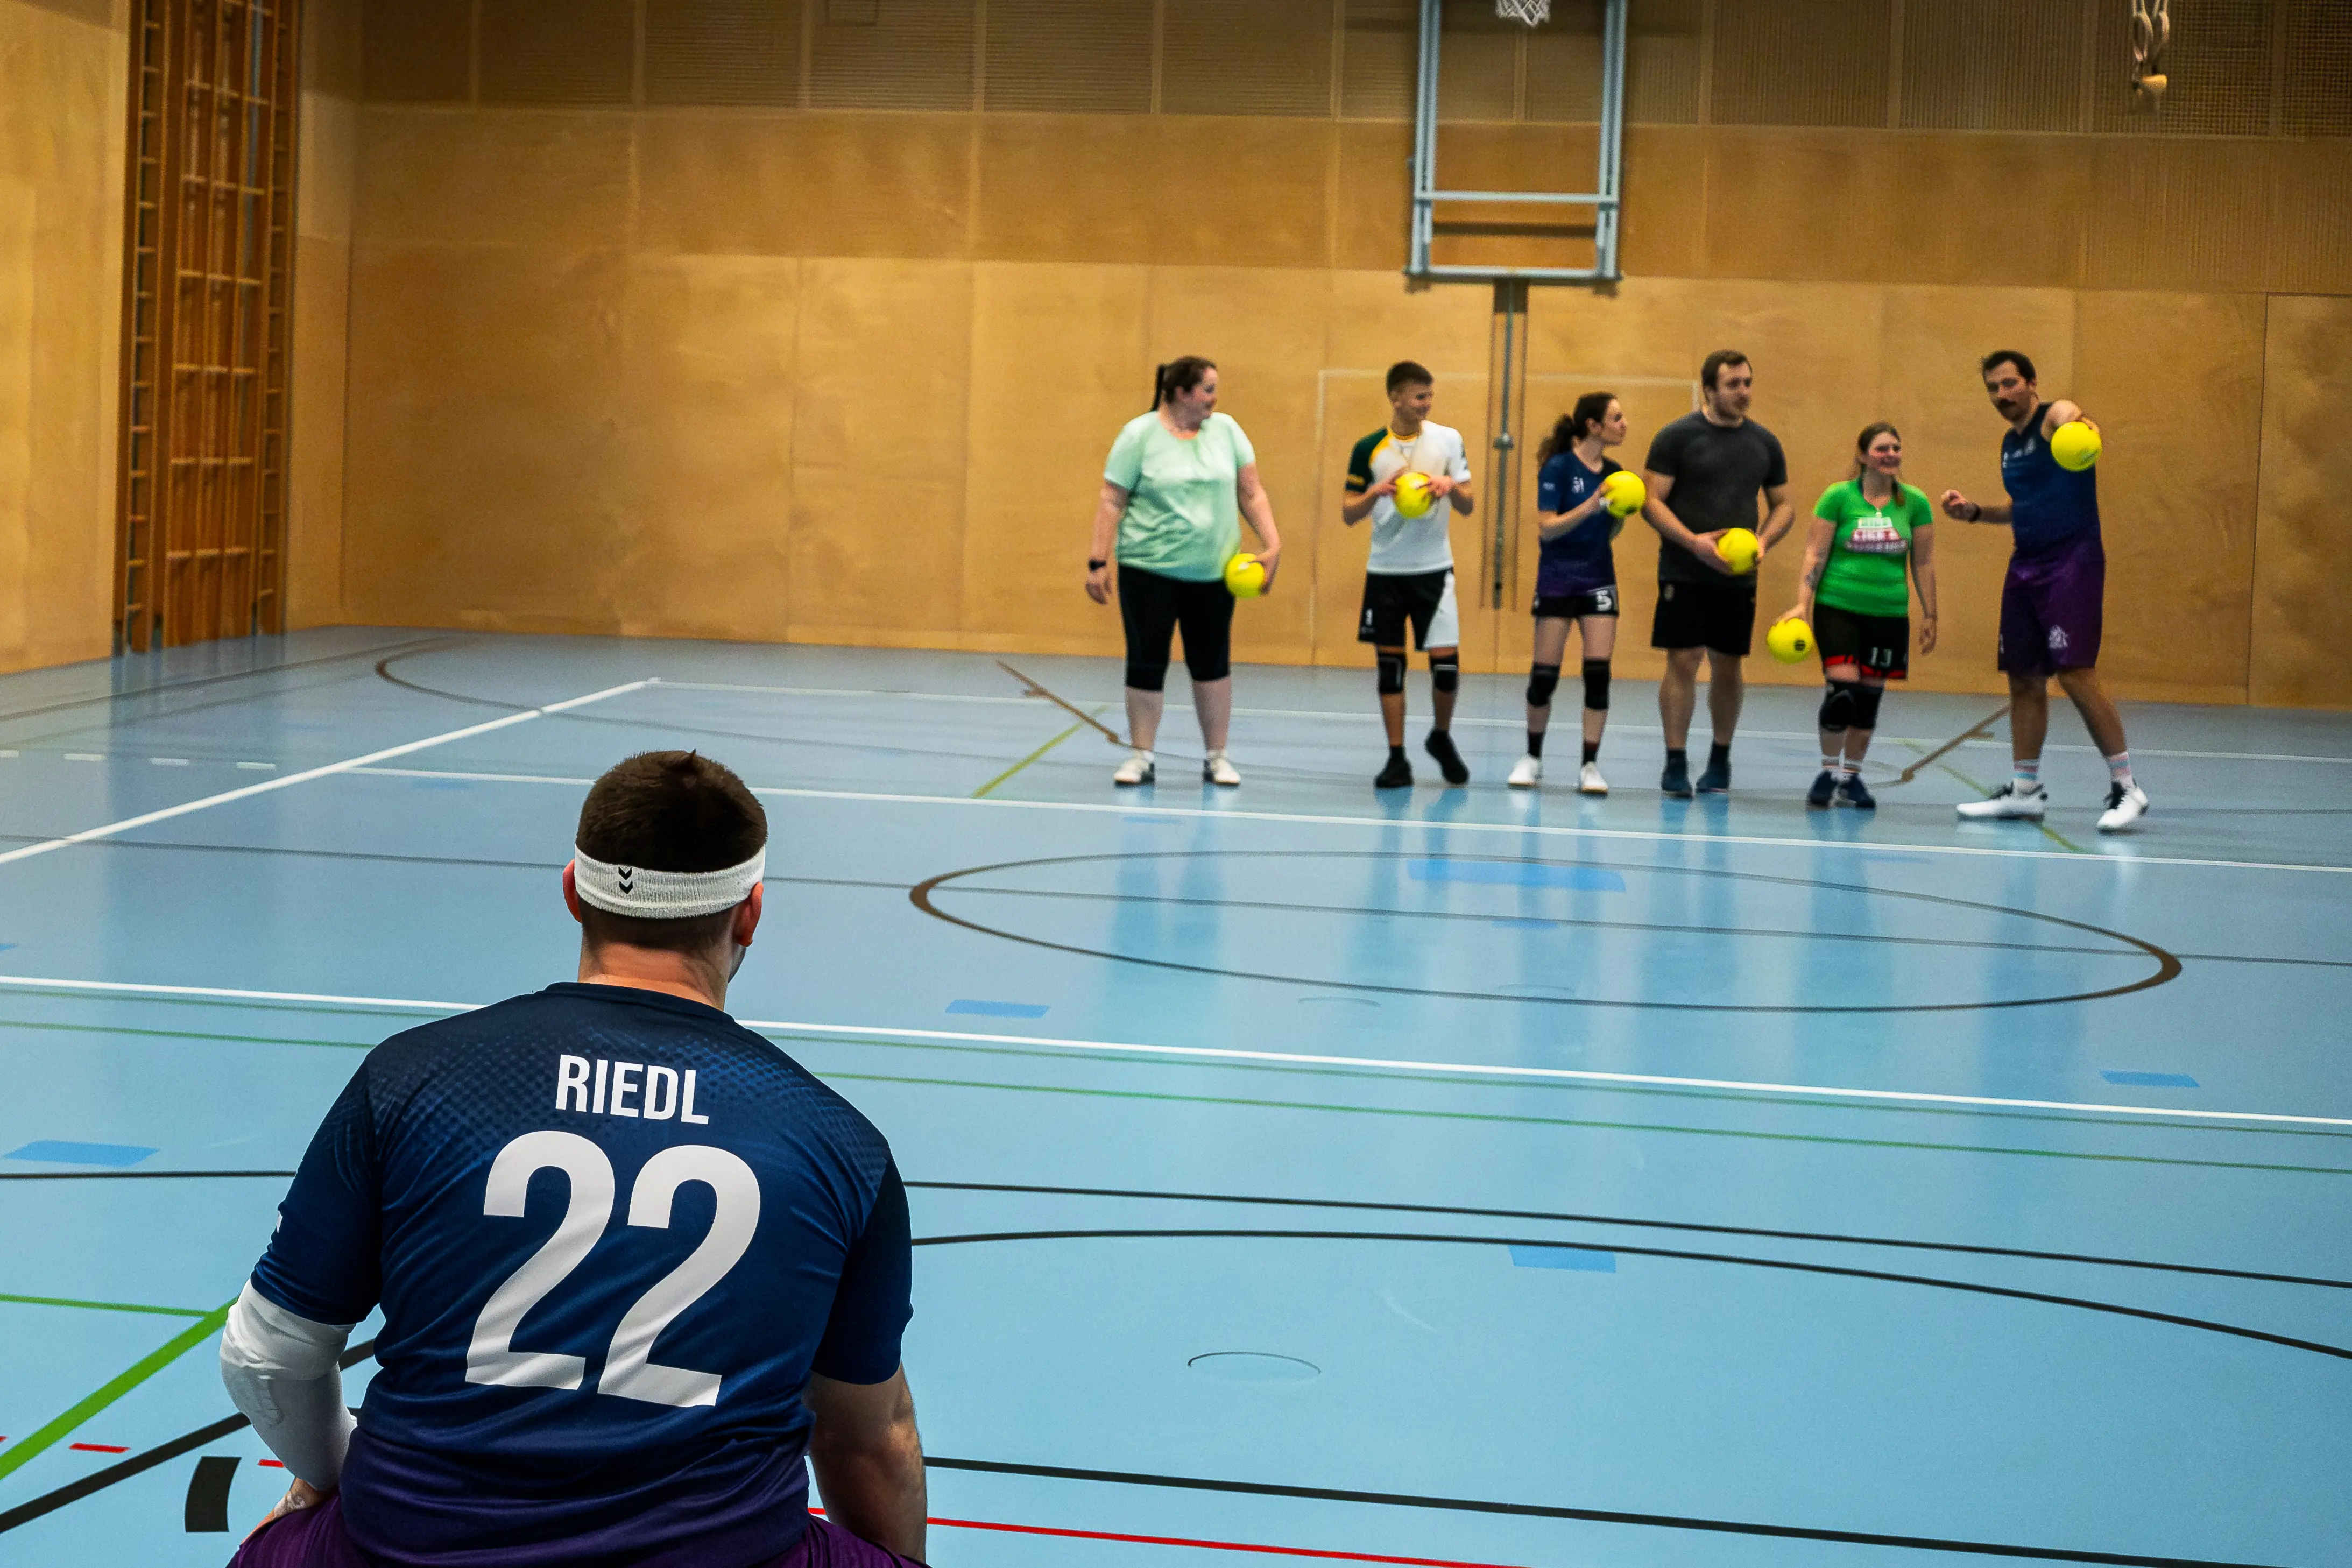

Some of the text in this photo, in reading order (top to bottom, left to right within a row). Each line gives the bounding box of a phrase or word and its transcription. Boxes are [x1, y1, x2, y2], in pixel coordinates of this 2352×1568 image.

[1595, 589, 1613, 612] 5
[1869, 646, 1892, 668] 13
[555, 1053, 710, 1125] RIEDL
[464, 1129, 761, 1408] 22
